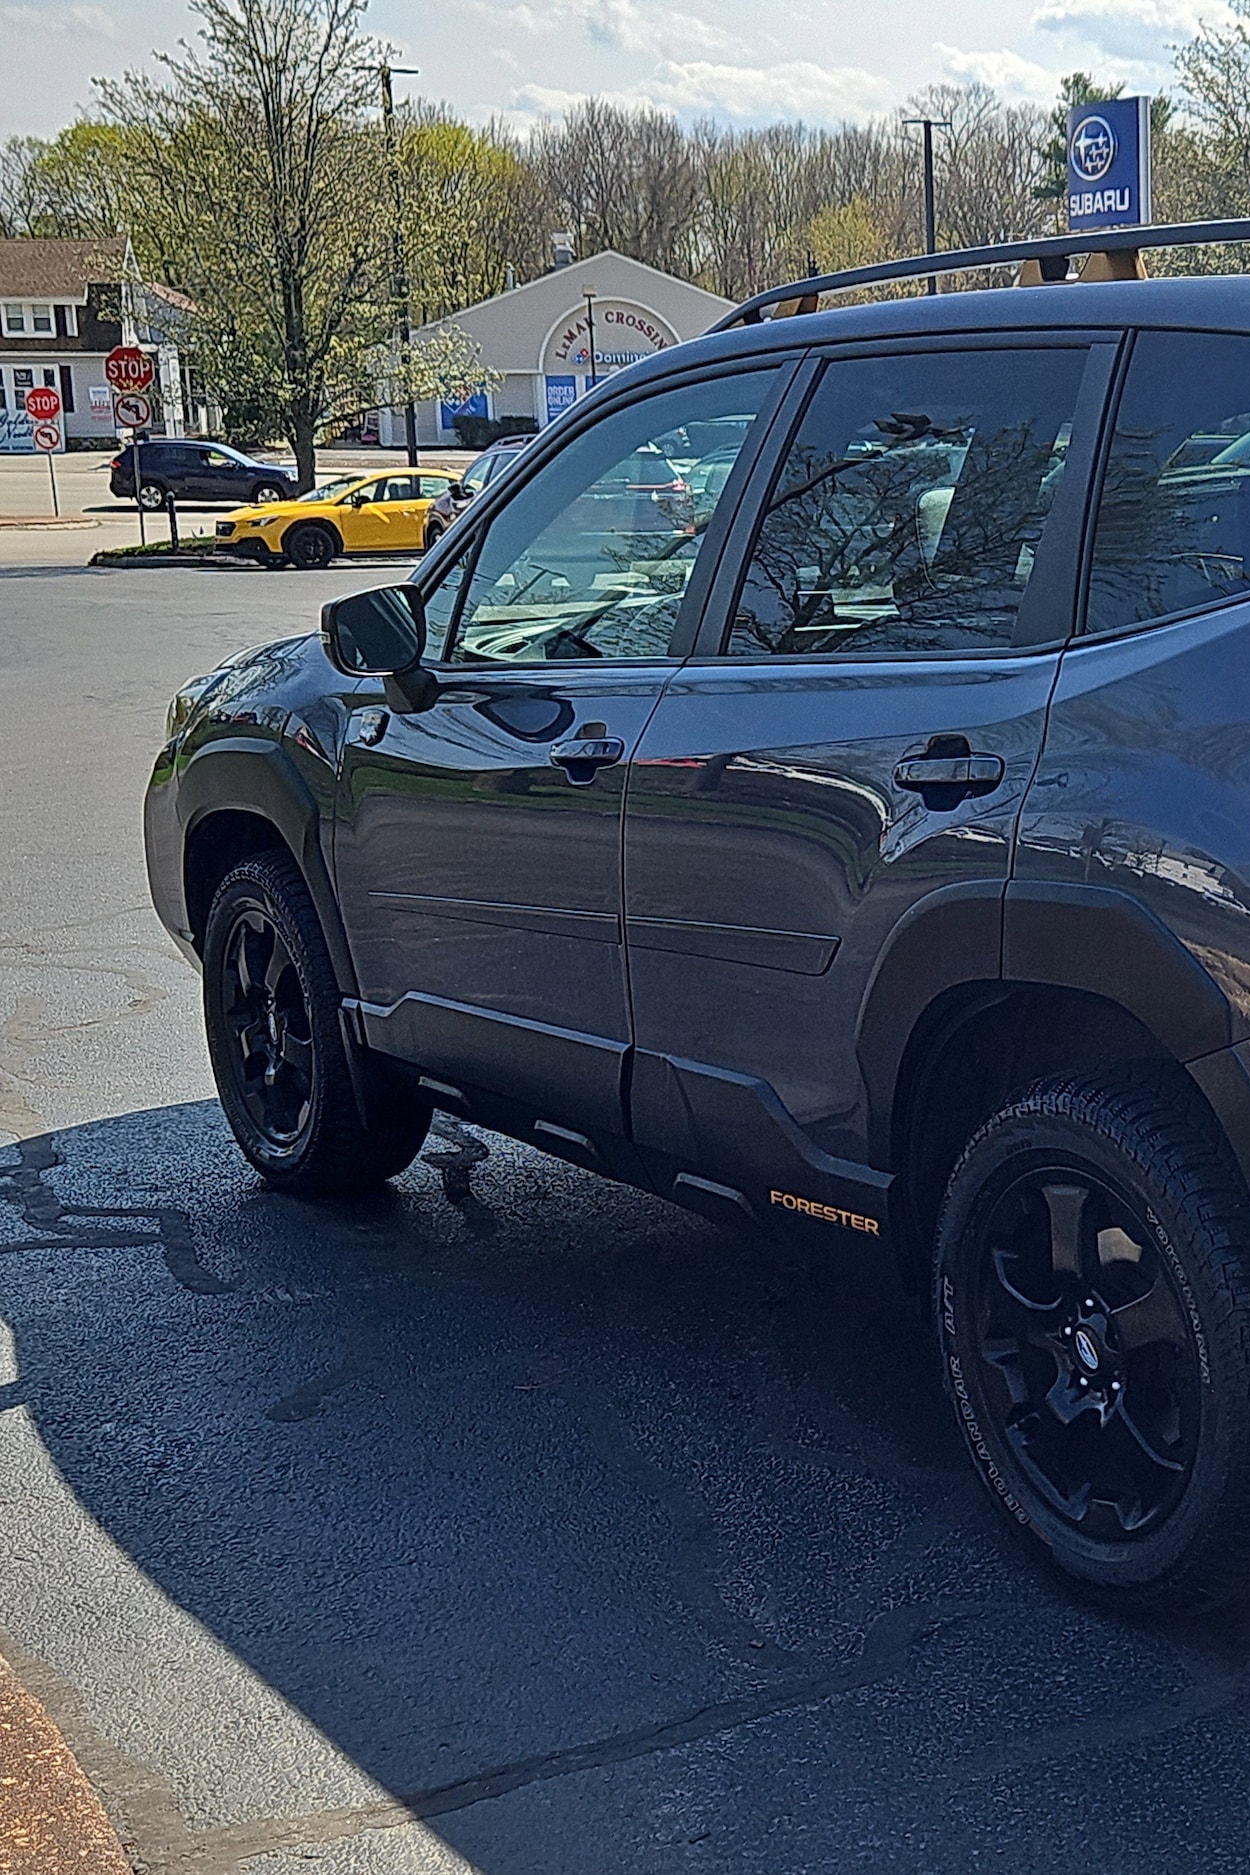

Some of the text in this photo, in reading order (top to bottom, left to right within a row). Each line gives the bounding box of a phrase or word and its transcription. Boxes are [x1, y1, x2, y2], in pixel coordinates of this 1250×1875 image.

[1069, 187, 1130, 217] SUBARU
[604, 311, 669, 351] CROSSIN
[108, 360, 150, 379] STOP
[547, 386, 575, 396] ORDER
[28, 396, 58, 411] STOP
[769, 1190, 880, 1236] FORESTER
